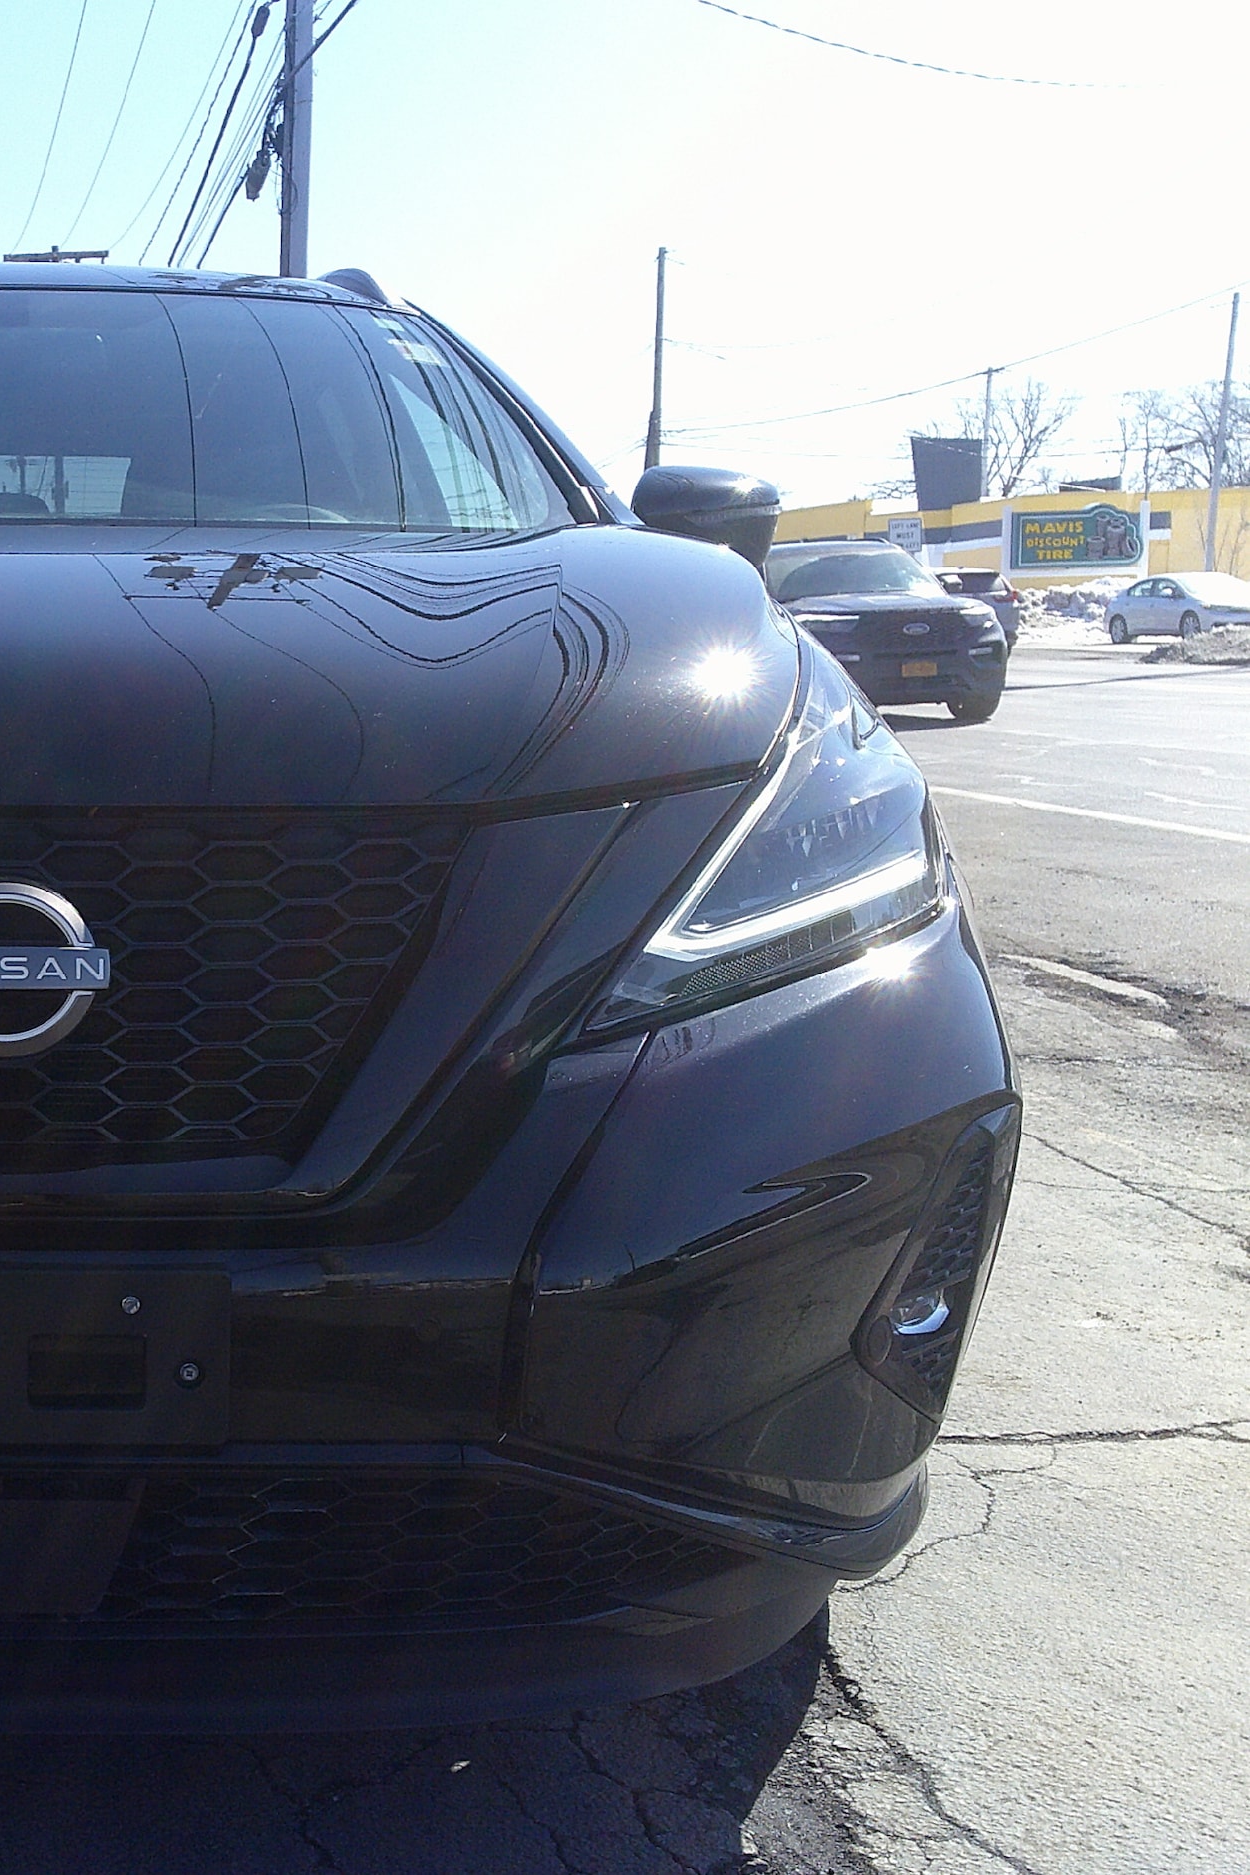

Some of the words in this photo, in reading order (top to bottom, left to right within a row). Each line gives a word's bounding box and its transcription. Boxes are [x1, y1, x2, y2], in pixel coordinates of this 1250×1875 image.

[1025, 521, 1084, 534] MAVIS
[1026, 535, 1085, 548] DISCOUNT
[1037, 549, 1073, 560] TIRE
